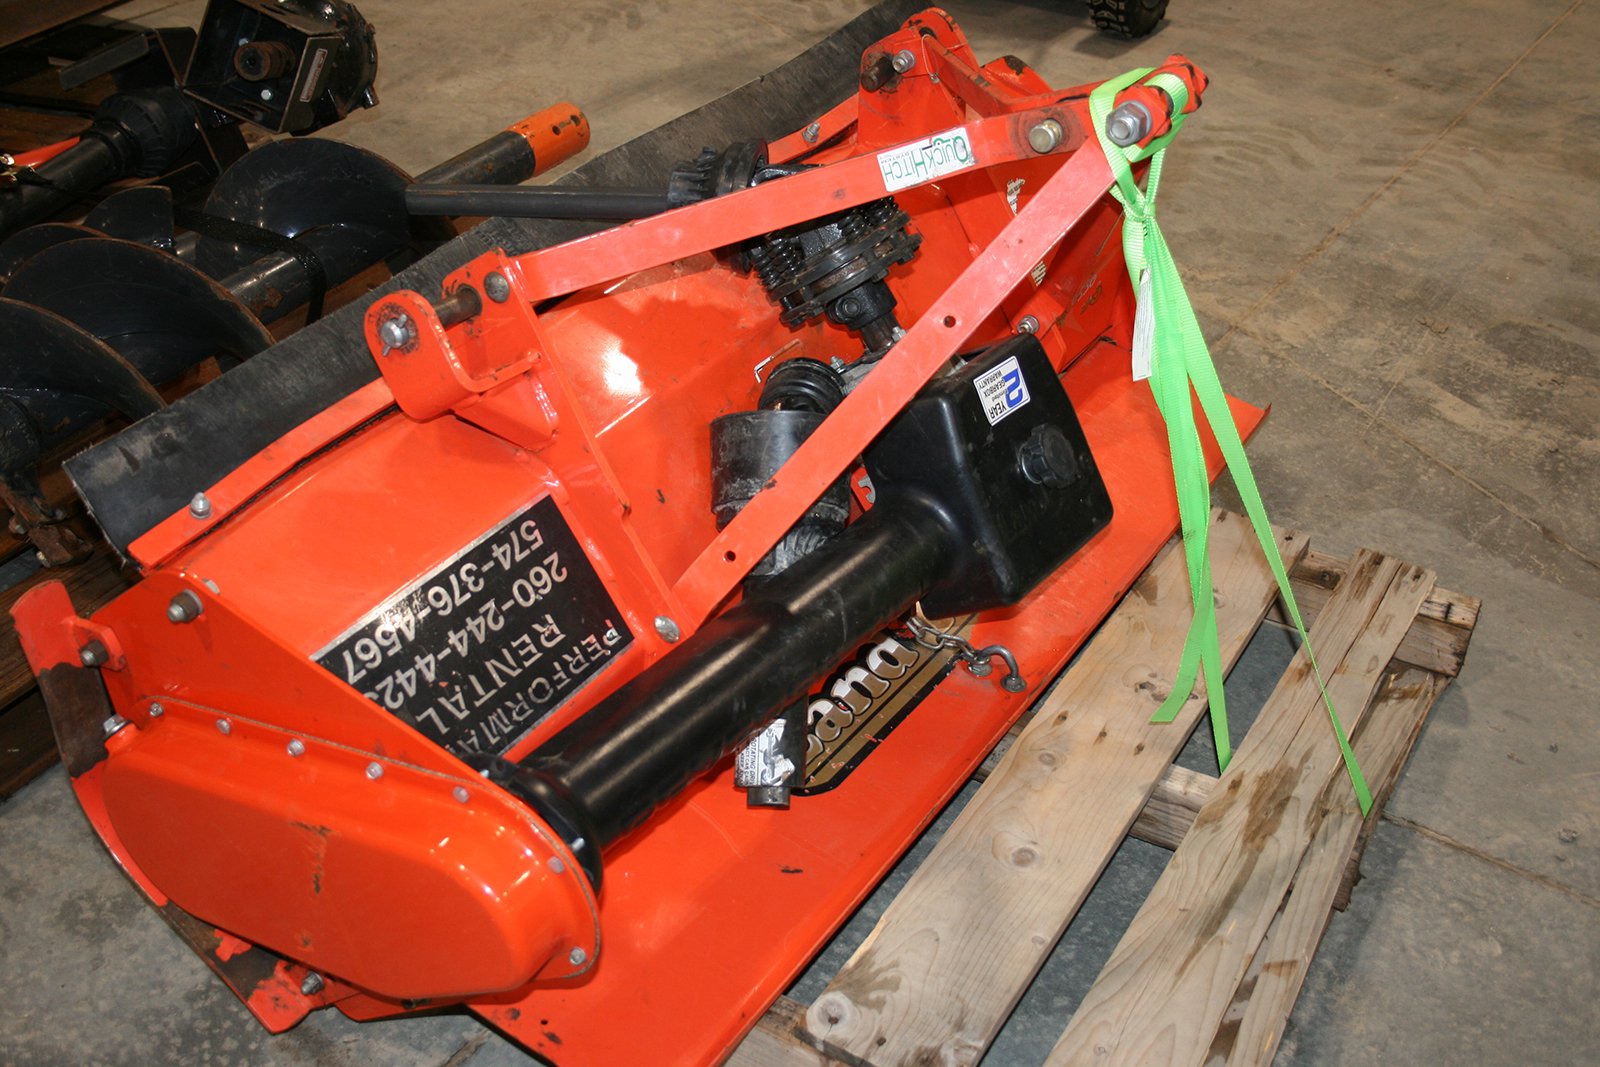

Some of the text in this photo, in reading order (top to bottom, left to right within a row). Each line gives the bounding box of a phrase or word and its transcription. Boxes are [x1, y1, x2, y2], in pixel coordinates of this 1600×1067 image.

[978, 370, 1002, 389] WARRANTY
[983, 379, 1005, 398] GEARBOX
[988, 368, 1023, 419] 2 YEAR
[341, 519, 545, 685] 574-376-4567
[416, 614, 567, 736] RENTAL
[445, 617, 622, 755] PERFORMA
